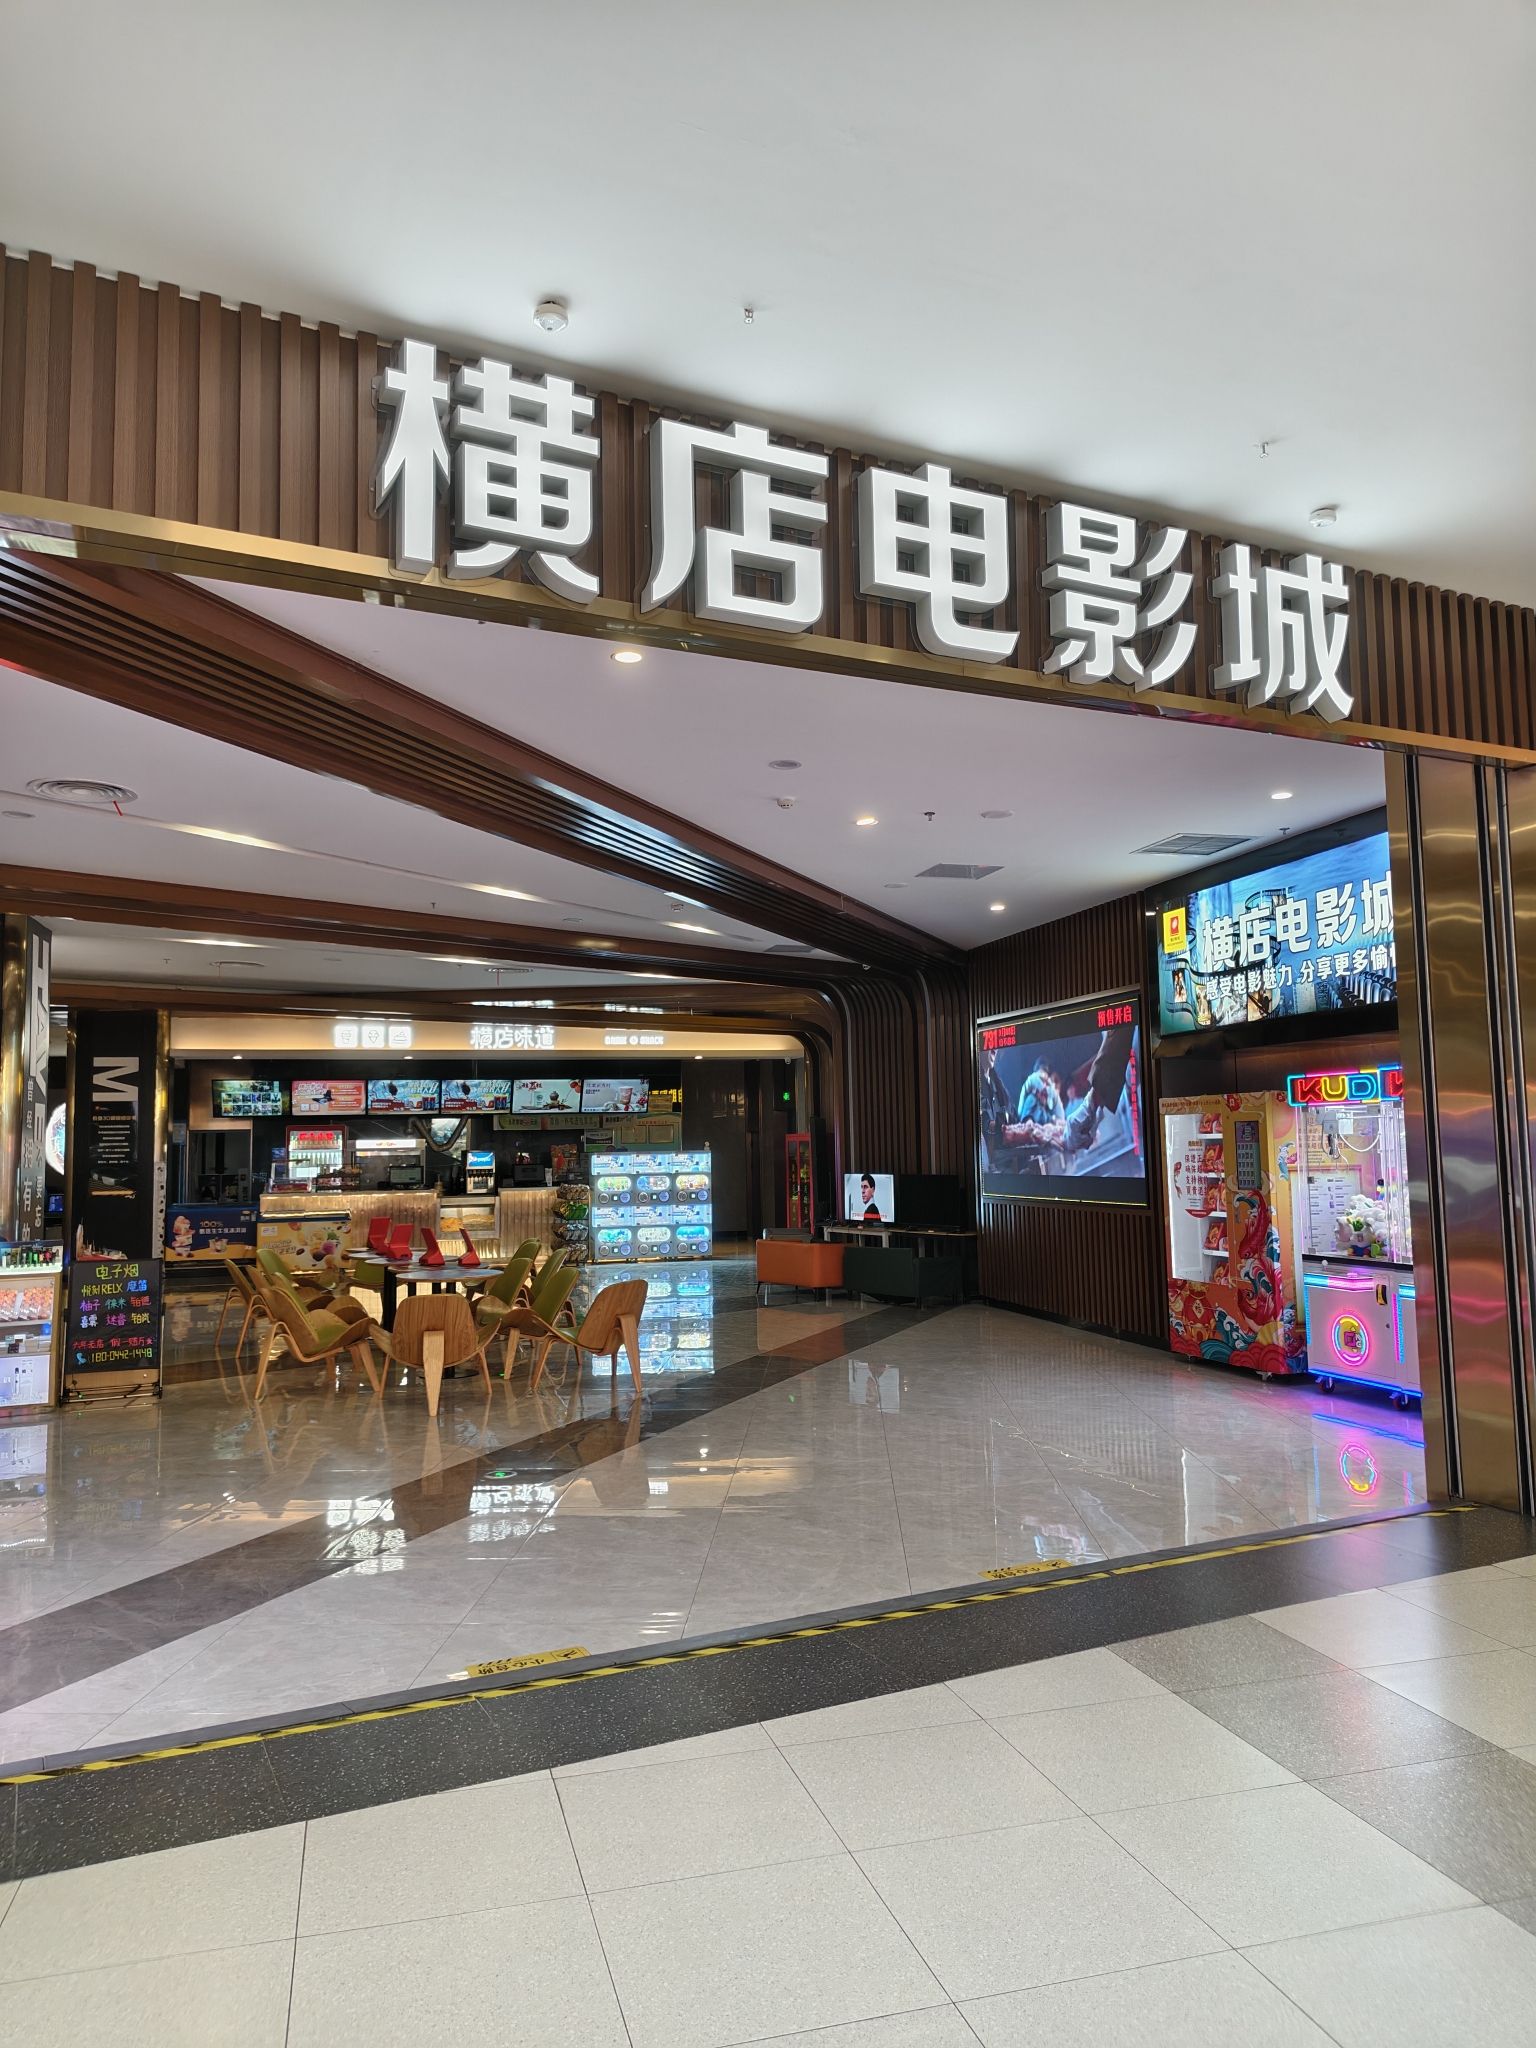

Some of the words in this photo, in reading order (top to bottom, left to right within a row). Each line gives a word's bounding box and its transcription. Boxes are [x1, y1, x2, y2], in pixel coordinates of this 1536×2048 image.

[382, 338, 1355, 722] 横店电影城
[1202, 870, 1395, 973] 横店电影城
[1098, 1005, 1132, 1027] 预售开启
[470, 1026, 554, 1050] 横店味道
[96, 1263, 139, 1280] 电子烟
[80, 1299, 101, 1312] 柚子
